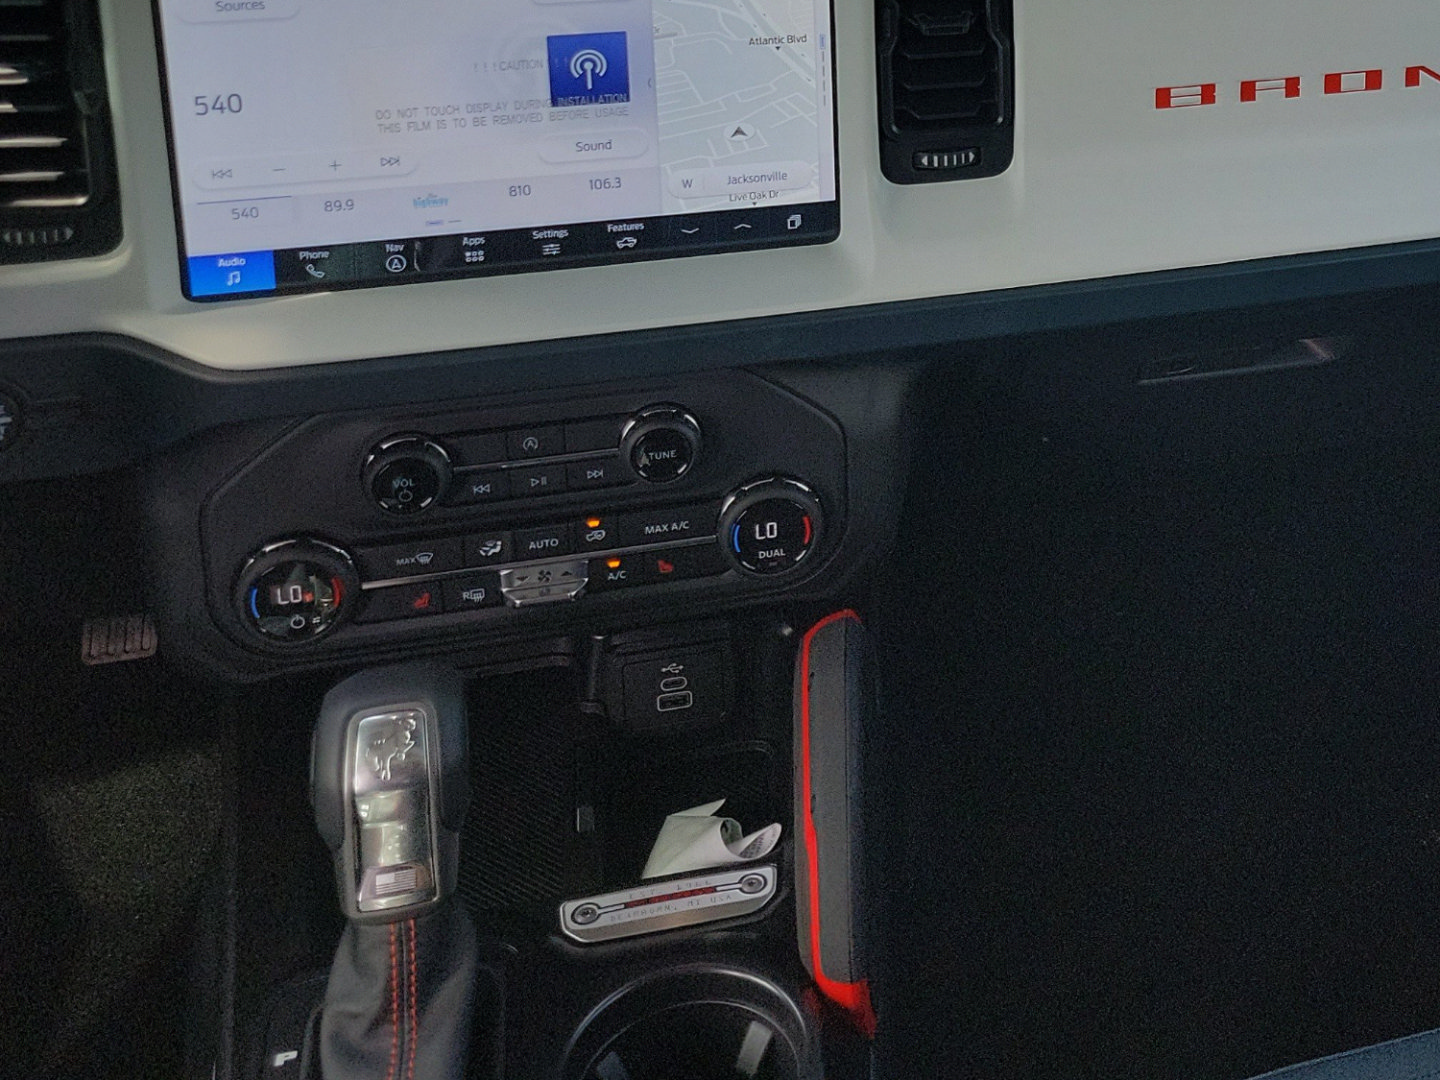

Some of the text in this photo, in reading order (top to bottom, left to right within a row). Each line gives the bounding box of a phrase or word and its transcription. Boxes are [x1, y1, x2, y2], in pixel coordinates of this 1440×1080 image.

[215, 0, 266, 12] Sources
[749, 33, 808, 46] Atlantic Blvd
[194, 93, 243, 116] 540
[375, 109, 392, 120] DO
[397, 107, 419, 118] NOT
[424, 104, 460, 117] TOUCH
[466, 100, 509, 114] DISPLAY
[377, 106, 630, 134] THIS FILM IS TO BE REMOVED BEFORE USAGE
[575, 138, 612, 153] Sound
[588, 177, 622, 191] 106.3
[681, 178, 693, 189] W
[727, 170, 788, 186] Jacksonville
[508, 184, 532, 197] 810
[729, 193, 748, 202] Live
[749, 191, 767, 201] Oak
[323, 199, 355, 213] 89.9
[231, 206, 259, 220] 540
[532, 227, 569, 240] Settings
[607, 222, 645, 233] Features
[462, 236, 486, 247] Apps
[385, 243, 405, 253] Nav
[299, 249, 330, 260] Phone
[217, 256, 246, 267] Audio
[648, 449, 677, 461] TUNE
[392, 477, 414, 488] VOL
[645, 520, 690, 535] MAX A/C
[755, 522, 778, 540] LO
[529, 538, 559, 550] AUTO
[758, 549, 786, 559] DUAL
[396, 555, 416, 566] MAX
[607, 570, 627, 581] A/C
[277, 585, 303, 606] LO
